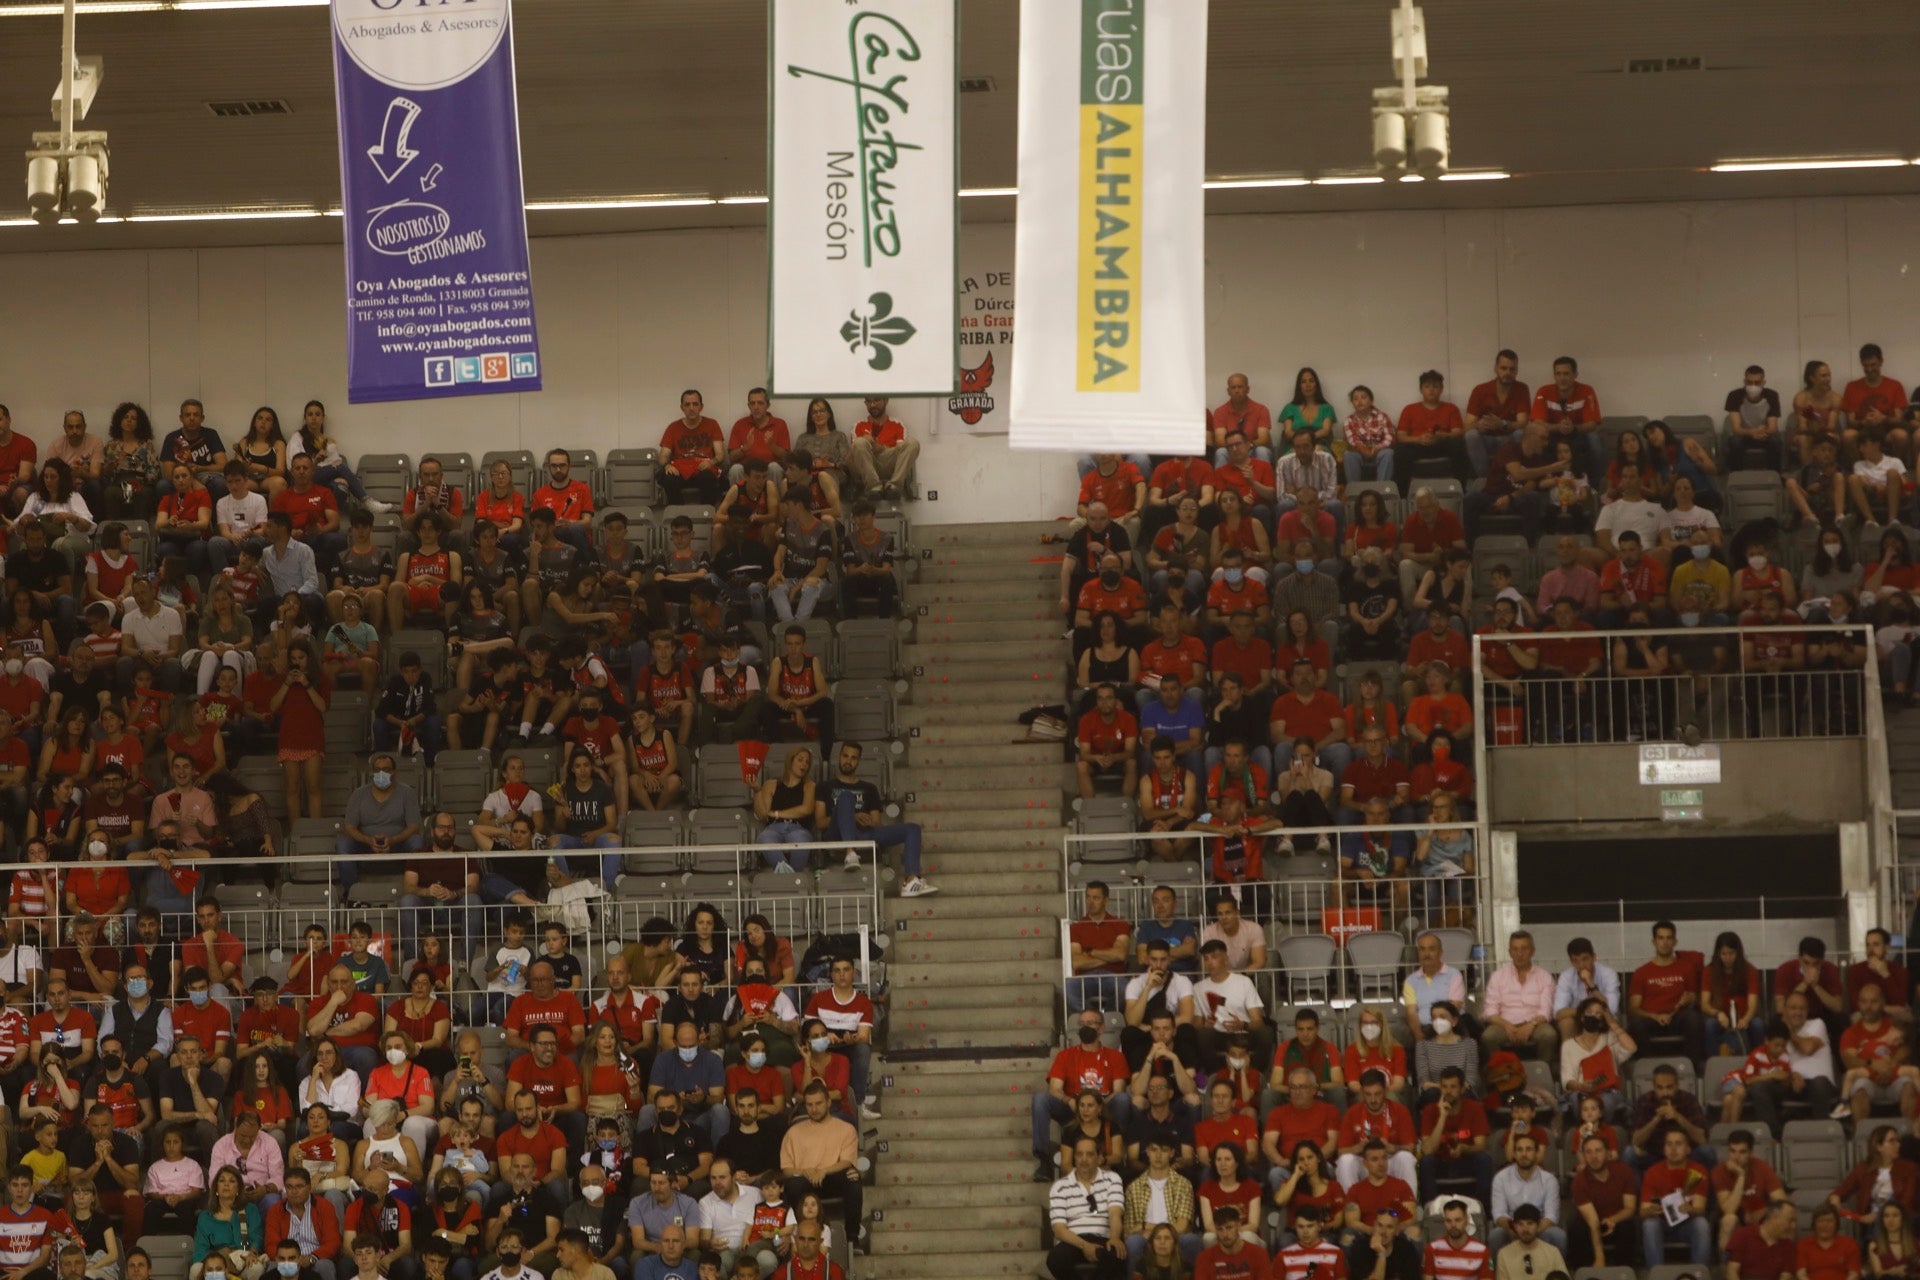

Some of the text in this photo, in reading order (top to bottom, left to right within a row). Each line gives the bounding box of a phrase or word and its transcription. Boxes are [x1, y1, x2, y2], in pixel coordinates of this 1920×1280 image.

[349, 17, 499, 40] Abogados & Asesores
[1096, 0, 1138, 102] úas
[826, 151, 855, 260] Mesón
[376, 211, 449, 248] NOSOTROS LO
[407, 229, 487, 266] GESTIONAMOS
[1093, 110, 1132, 385] ALHAMBRA
[356, 271, 528, 295] Oya Abogados & Asesores
[985, 272, 1011, 287] DE
[348, 296, 385, 308] Camino
[387, 294, 400, 305] de
[488, 285, 529, 298] Granada
[376, 308, 395, 320] 958
[396, 307, 415, 318] 094
[417, 306, 436, 317] 400
[447, 304, 468, 315] Fax.
[470, 302, 489, 313] 958
[491, 300, 509, 311] 094
[511, 299, 530, 310] 399
[377, 315, 532, 338] info@oyaabogados.com
[381, 333, 533, 354] www.oyaabogados.com
[950, 398, 993, 410] GRANADA
[1645, 748, 1664, 759] C3
